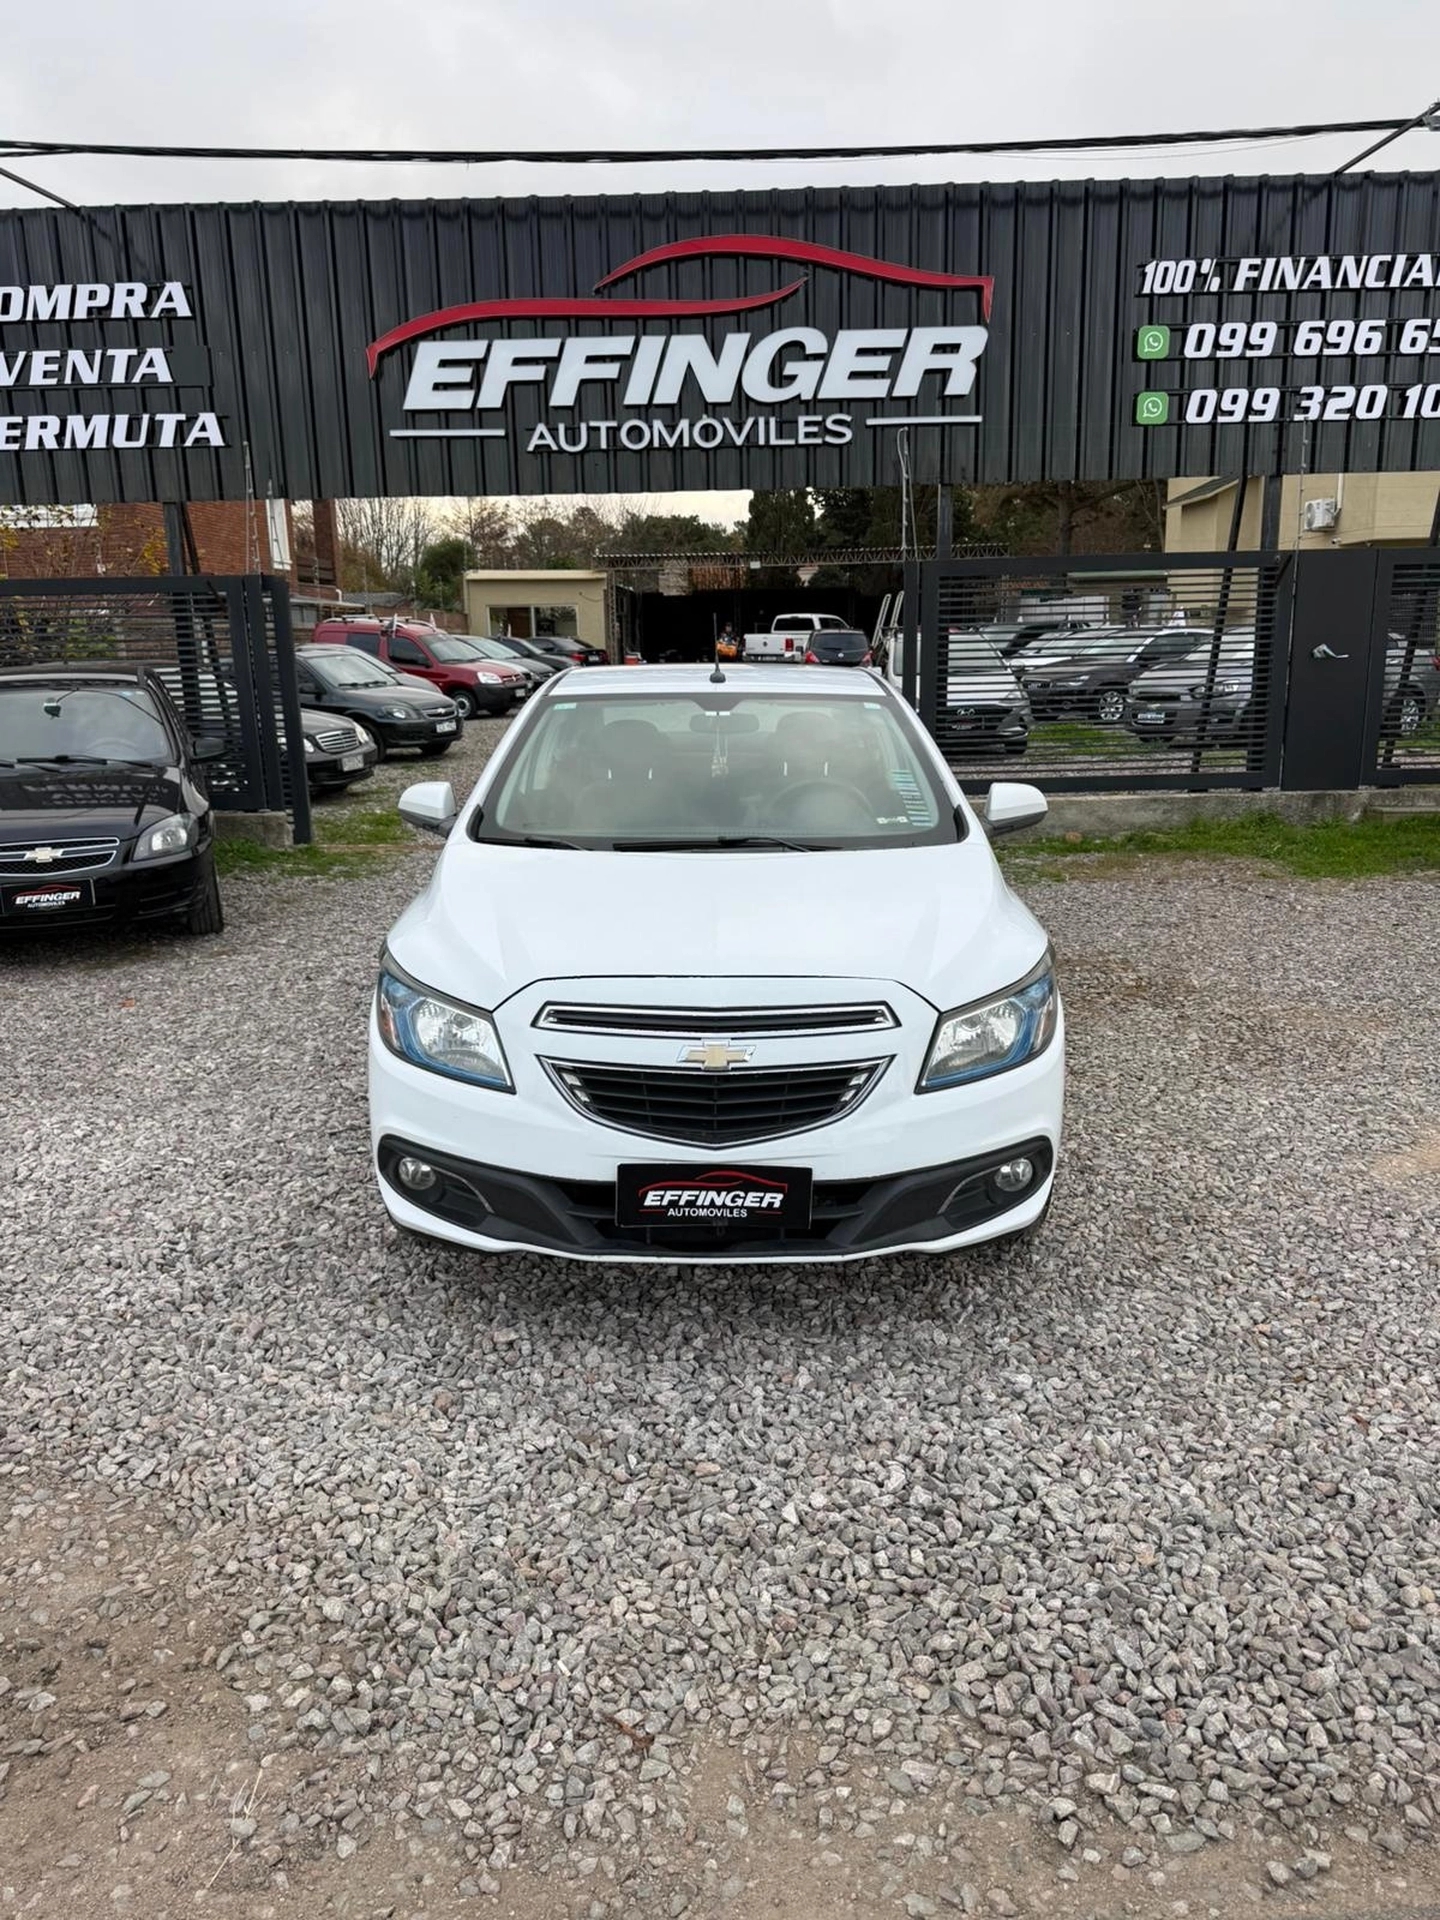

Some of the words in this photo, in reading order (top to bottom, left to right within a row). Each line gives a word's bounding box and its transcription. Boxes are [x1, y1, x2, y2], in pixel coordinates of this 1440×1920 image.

[1142, 258, 1221, 294] 100%
[1233, 254, 1440, 291] FINANCIA
[1184, 321, 1278, 359] 099
[1293, 319, 1386, 356] 696
[0, 348, 173, 386] VENTA
[403, 325, 989, 410] EFFINGER
[1185, 387, 1280, 424] 099
[1293, 384, 1388, 421] 320
[15, 891, 81, 905] EFFINGER
[643, 1190, 784, 1209] EFFINGER
[667, 1207, 748, 1218] AUTOMOVILES
